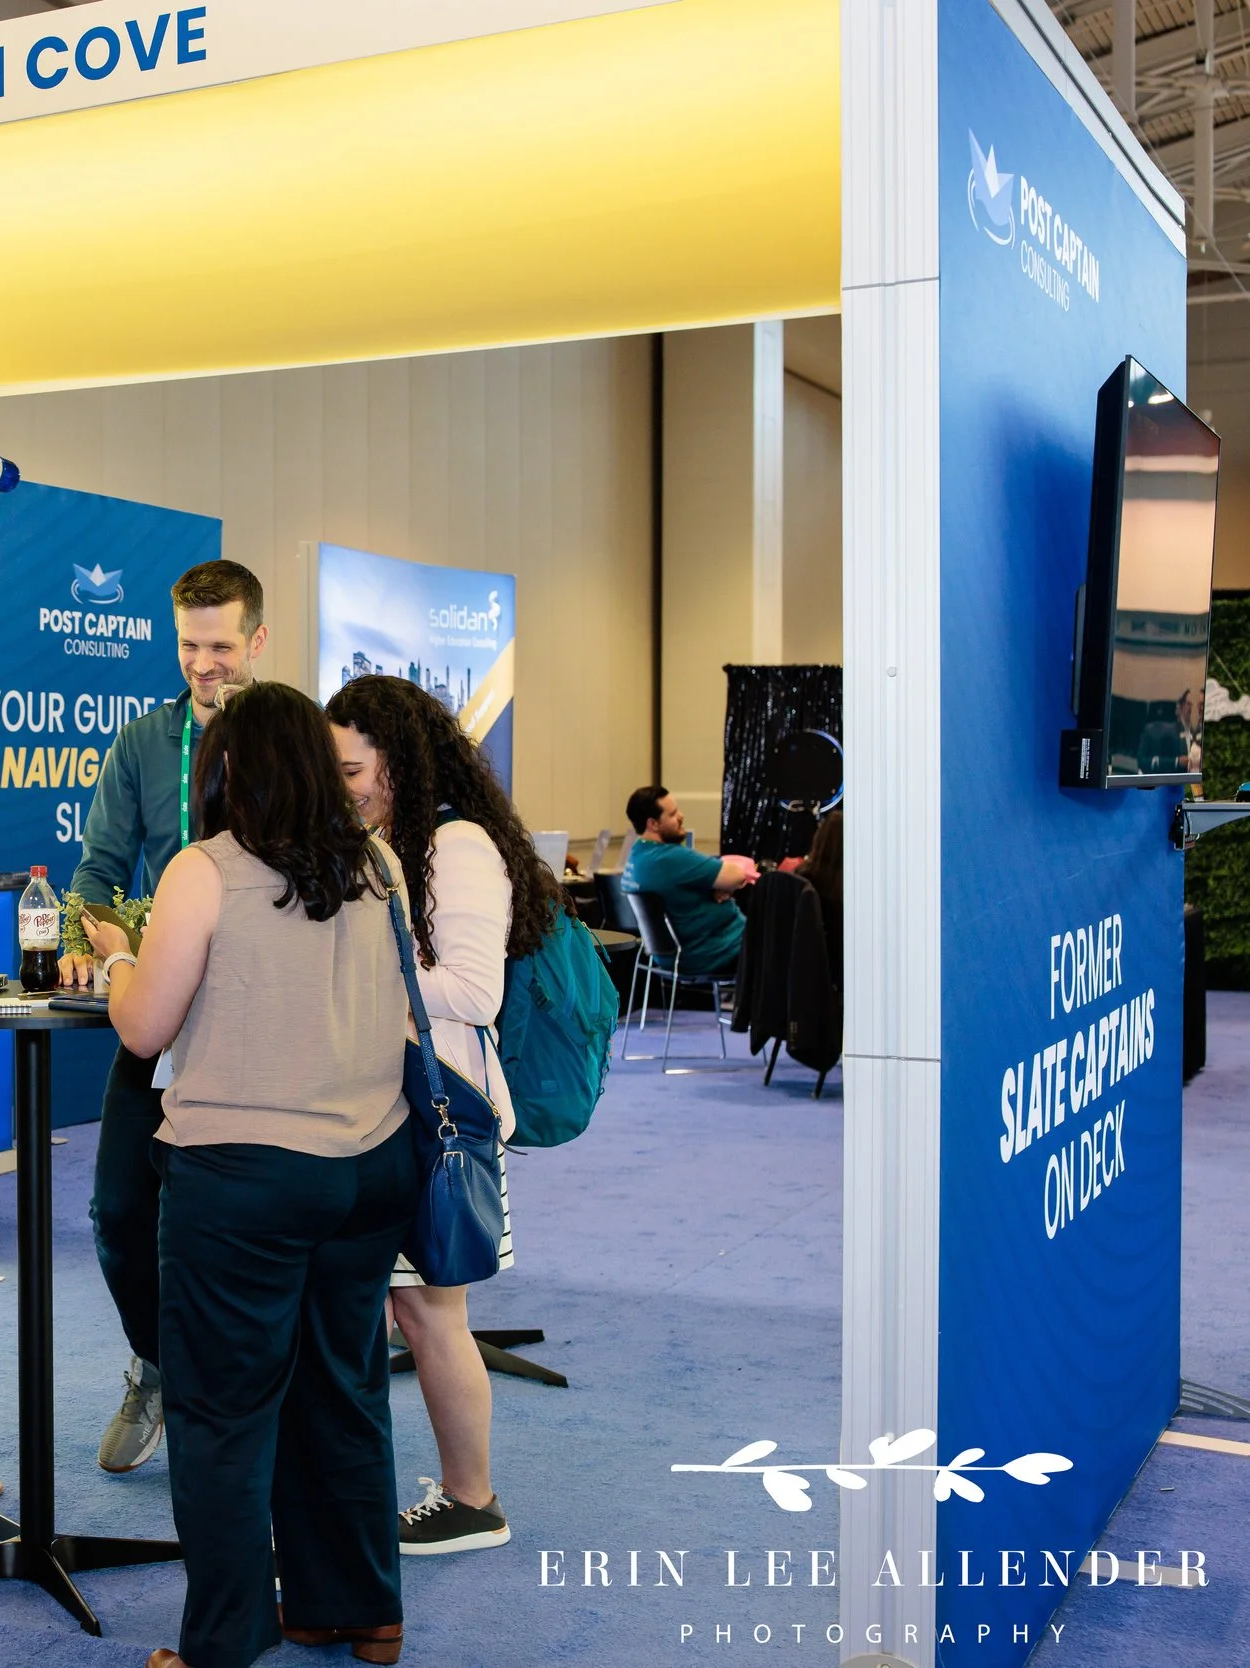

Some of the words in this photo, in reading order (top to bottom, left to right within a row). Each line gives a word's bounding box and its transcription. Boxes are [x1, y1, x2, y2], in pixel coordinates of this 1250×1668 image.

[25, 6, 207, 90] COVE
[1020, 175, 1053, 251] POST
[1053, 214, 1100, 303] CAPTAIN
[1020, 239, 1070, 312] CONSULTING
[39, 607, 83, 635] POST
[84, 612, 152, 642] CAPTAIN
[63, 639, 130, 659] CONSULTING
[1050, 913, 1122, 1020] FORMER
[1000, 1038, 1068, 1164] SLATE
[1069, 988, 1155, 1114] CAPTAINS
[1044, 1140, 1074, 1240] ON
[1080, 1099, 1126, 1212] DECK
